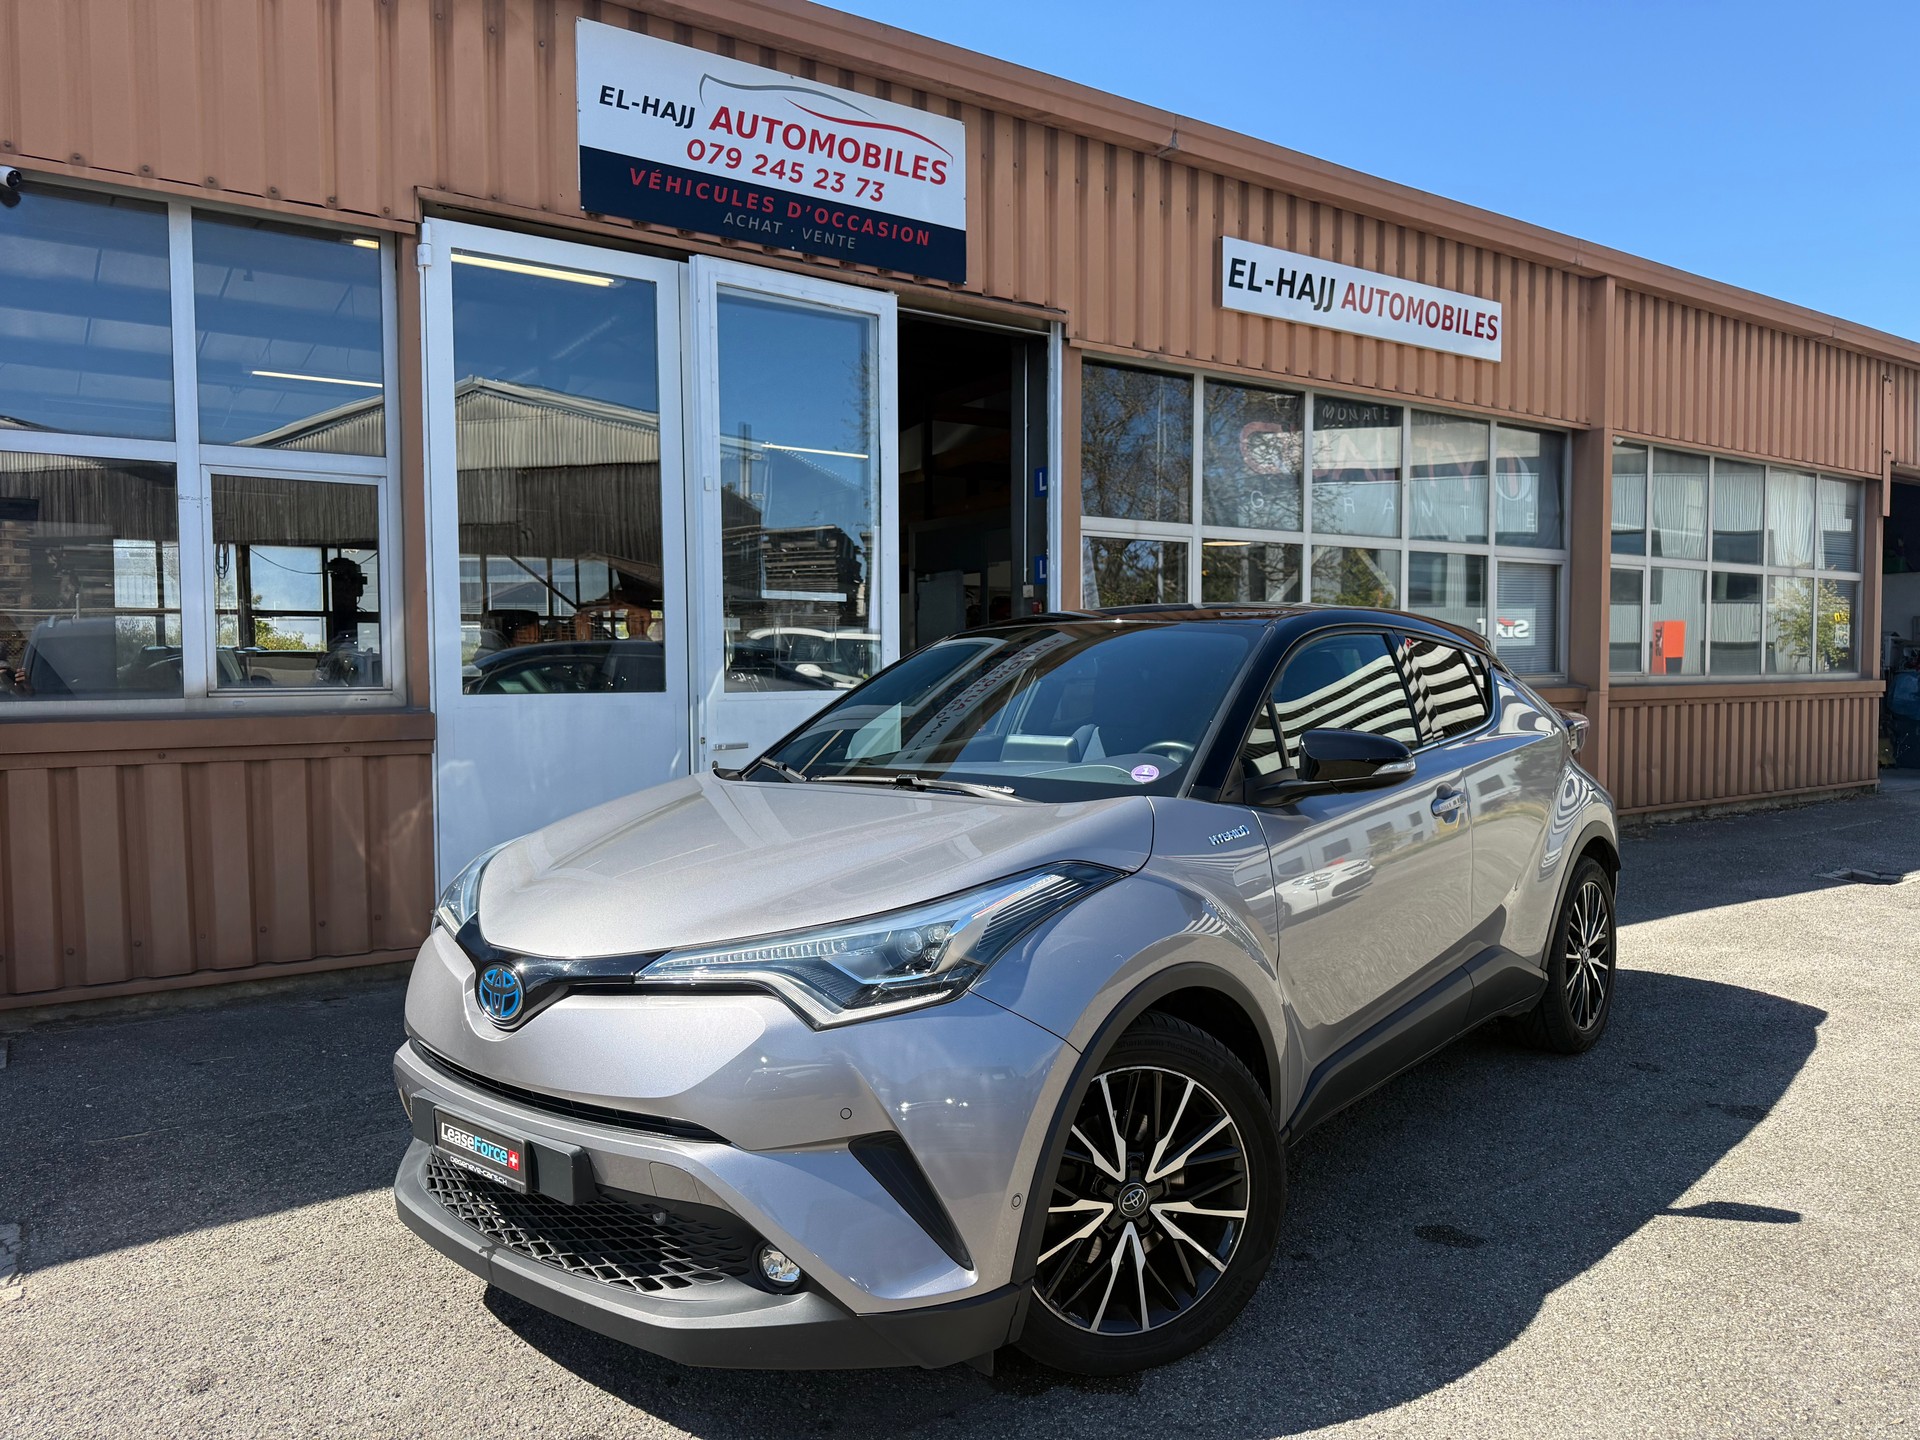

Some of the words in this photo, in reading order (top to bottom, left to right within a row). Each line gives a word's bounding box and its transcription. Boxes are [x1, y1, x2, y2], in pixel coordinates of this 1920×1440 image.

[599, 84, 696, 130] EL-HAJJ
[708, 105, 948, 186] AUTOMOBILES
[686, 138, 742, 170] 079
[751, 153, 804, 183] 245
[813, 167, 846, 193] 23
[856, 176, 886, 202] 73
[629, 167, 776, 213] VÉHICULES
[787, 201, 931, 247] D'OCCASION
[723, 211, 784, 235] ACHAT
[802, 227, 857, 250] VENTE
[1228, 257, 1336, 313] EL-HAJJ
[1340, 282, 1498, 342] AUTOMOBILES
[441, 1122, 508, 1164] LeaseForce
